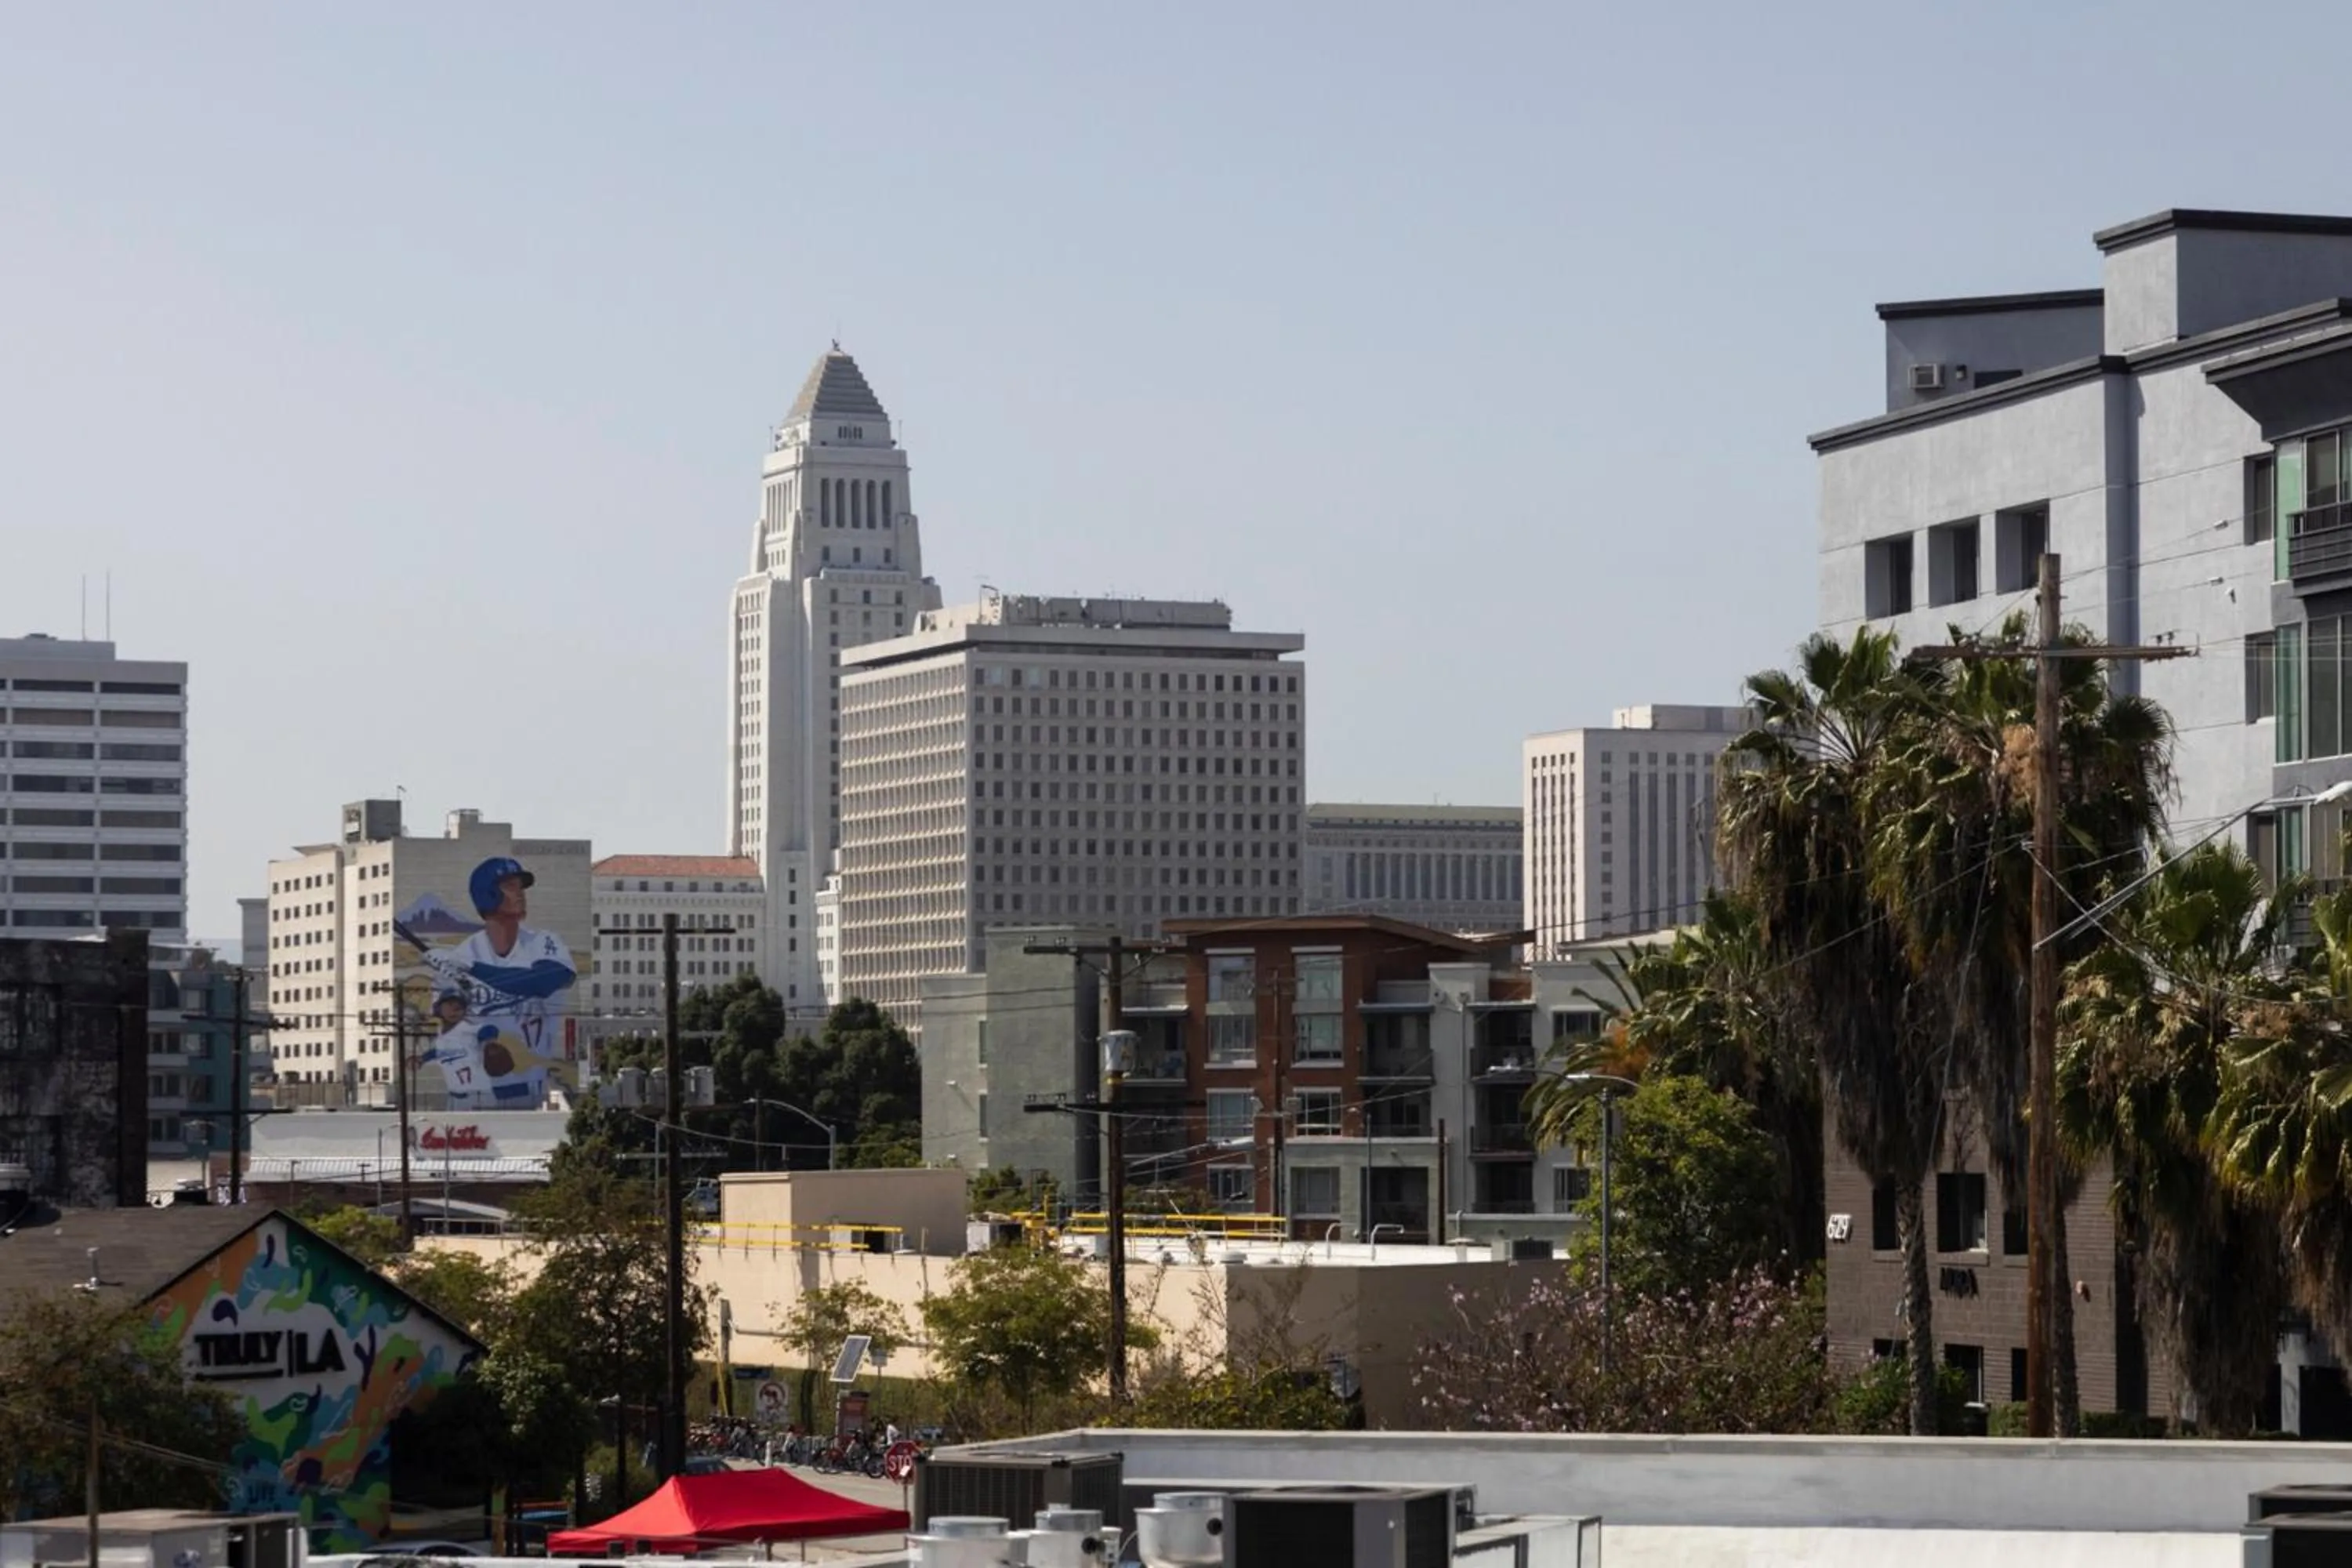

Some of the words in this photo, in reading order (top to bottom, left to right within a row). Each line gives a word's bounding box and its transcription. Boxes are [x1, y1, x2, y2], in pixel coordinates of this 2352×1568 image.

[521, 1017, 543, 1048] 17
[456, 1065, 472, 1086] 17
[194, 1330, 283, 1367] TRULY
[295, 1328, 347, 1375] LA
[887, 1454, 913, 1472] STO
